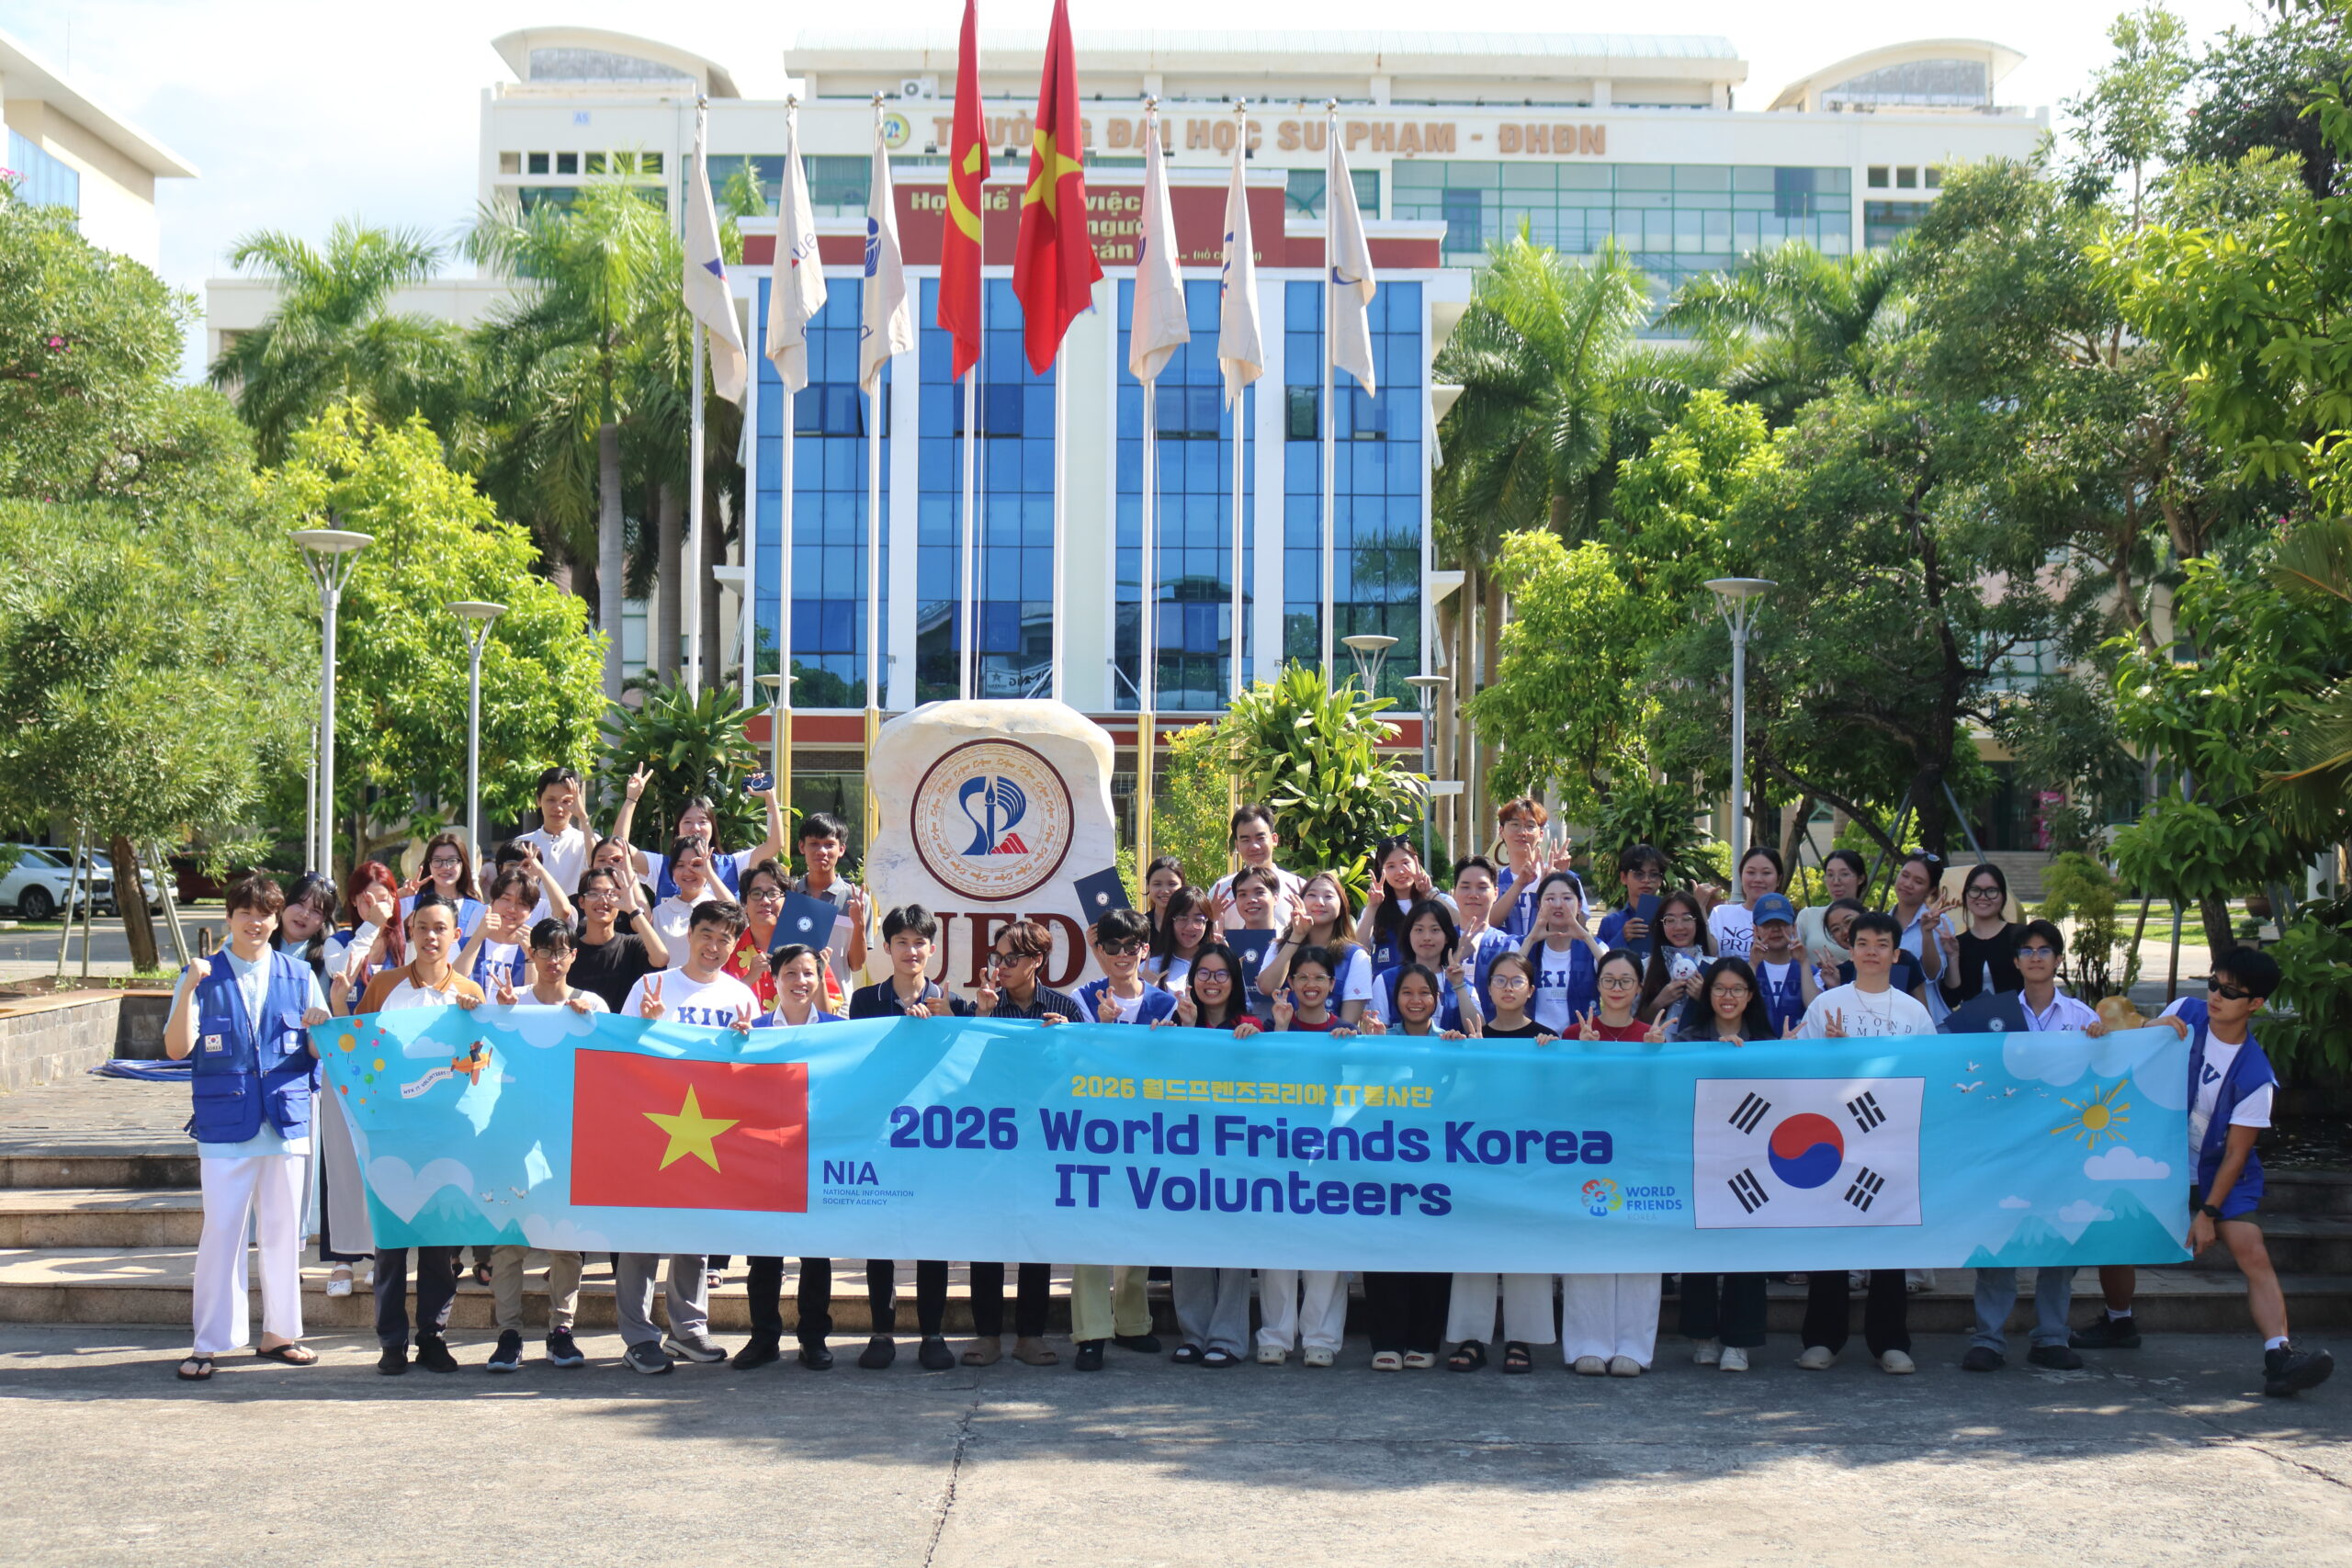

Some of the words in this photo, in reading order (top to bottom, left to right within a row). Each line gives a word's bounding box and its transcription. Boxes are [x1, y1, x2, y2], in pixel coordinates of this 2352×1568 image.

[1186, 119, 1262, 156] HỌC
[1345, 121, 1456, 157] PHẠM
[1498, 123, 1606, 155] ĐHĐN
[911, 191, 947, 216] Họ
[1719, 938, 1755, 953] PRI
[1842, 1014, 1912, 1034] EYOND
[1071, 1075, 1136, 1099] 2026
[1142, 1078, 1329, 1106] 월드프렌즈코리아
[890, 1105, 1019, 1150] 2026
[1039, 1108, 1200, 1156] World
[1215, 1114, 1430, 1163] Friends
[1445, 1121, 1613, 1165] Korea
[823, 1160, 879, 1186] NIA
[862, 1190, 914, 1198] INFORMATION
[1055, 1163, 1111, 1208] IT
[1125, 1166, 1453, 1217] Volunteers
[1625, 1186, 1676, 1198] WORLD
[1626, 1200, 1682, 1211] FRIENDS
